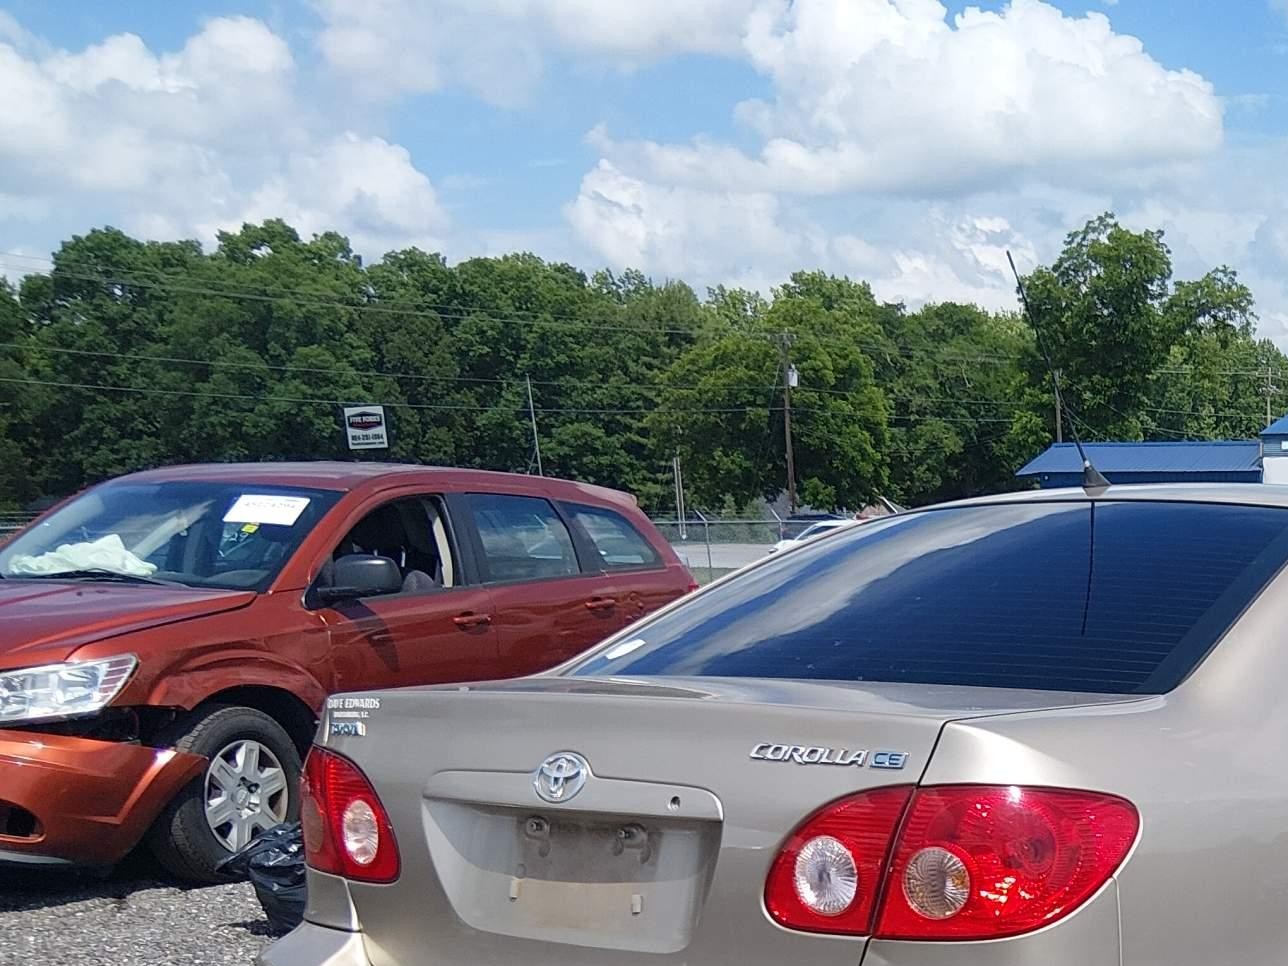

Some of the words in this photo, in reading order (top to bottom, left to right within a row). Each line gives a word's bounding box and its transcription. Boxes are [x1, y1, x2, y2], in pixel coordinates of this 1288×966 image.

[345, 698, 381, 709] EDWARDS
[749, 743, 869, 767] COROLLA
[872, 750, 905, 767] CE
